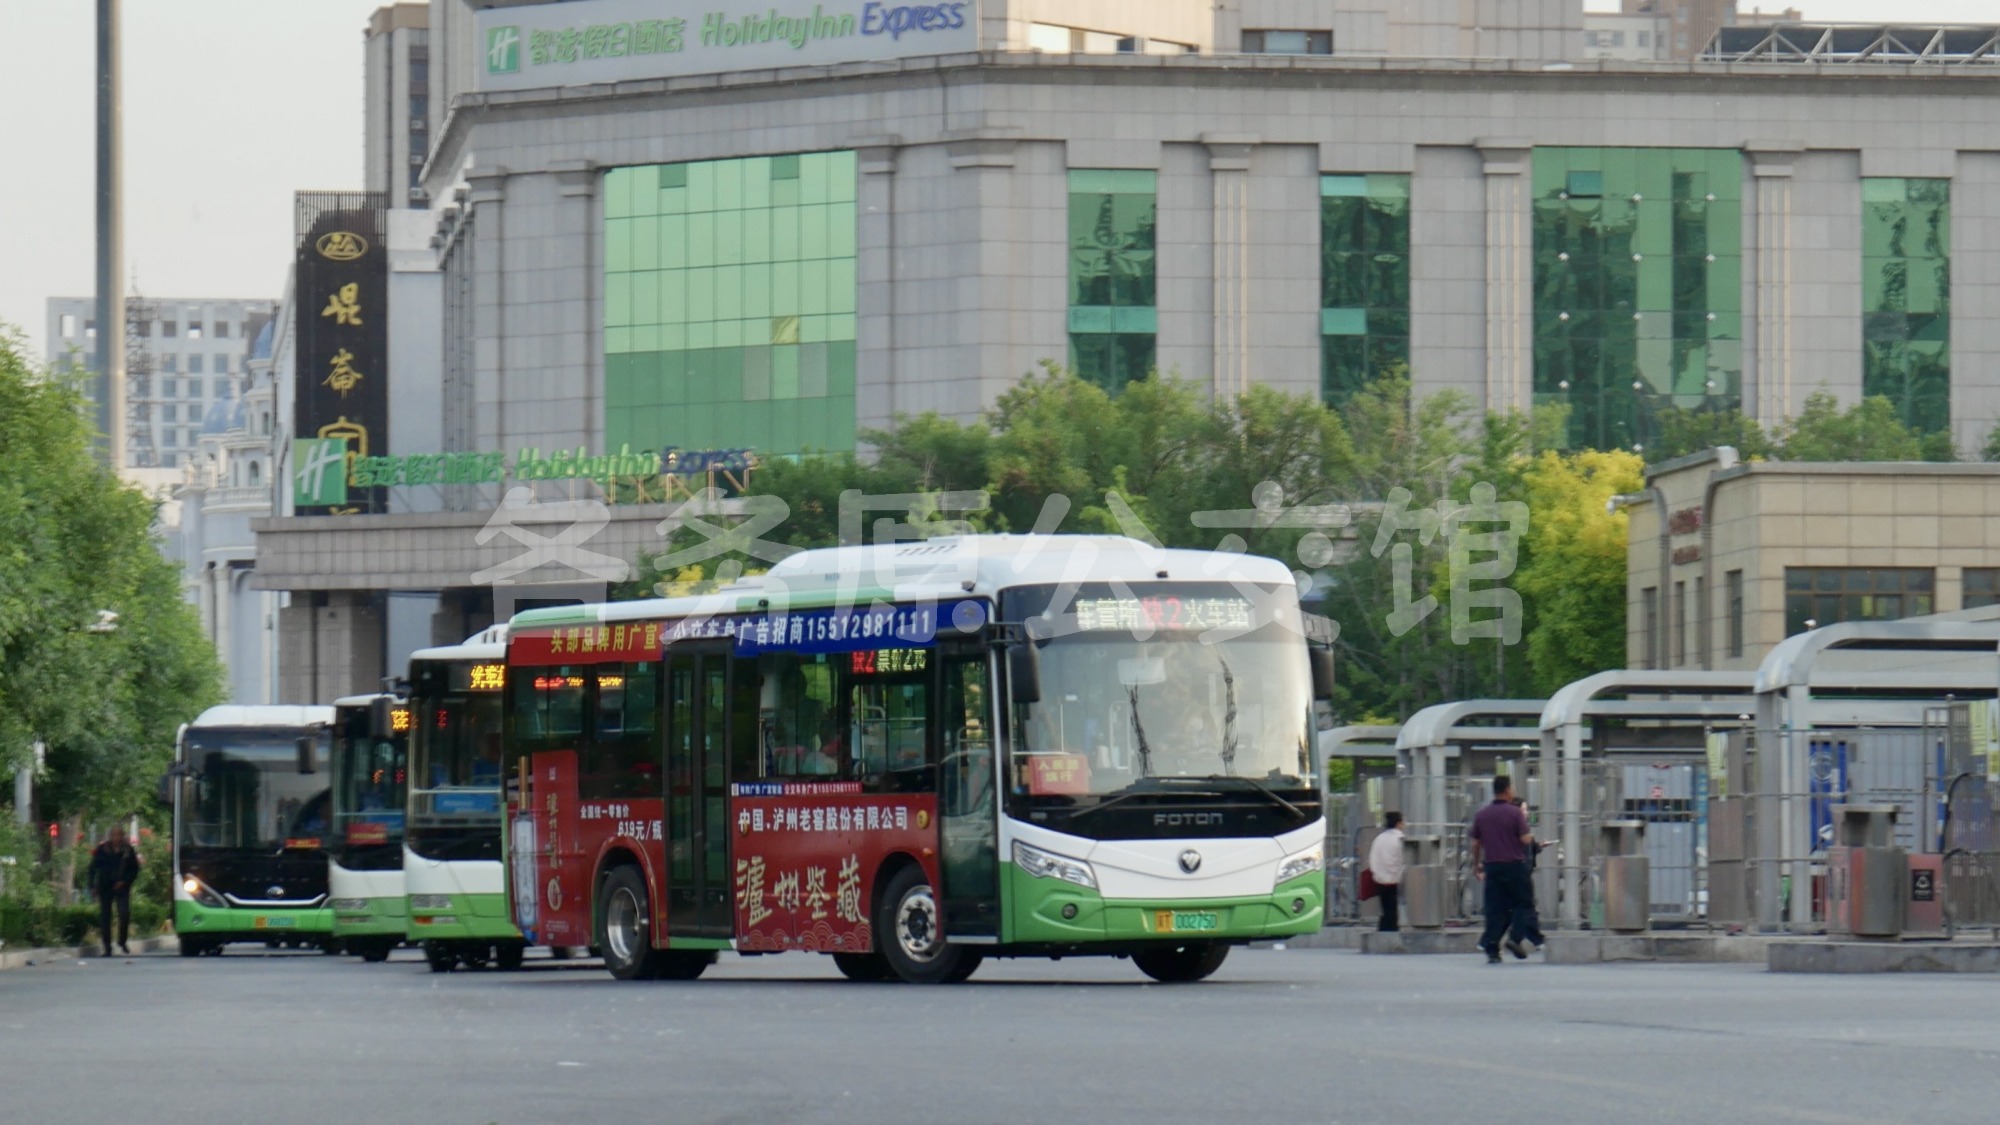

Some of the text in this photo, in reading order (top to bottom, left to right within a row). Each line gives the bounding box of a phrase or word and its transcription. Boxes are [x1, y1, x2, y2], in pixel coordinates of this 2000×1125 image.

[860, 1, 968, 40] Express
[529, 16, 687, 66] 智选假日酒店
[551, 622, 658, 654] 头部品牌用广宣
[1153, 812, 1224, 827] FOTON
